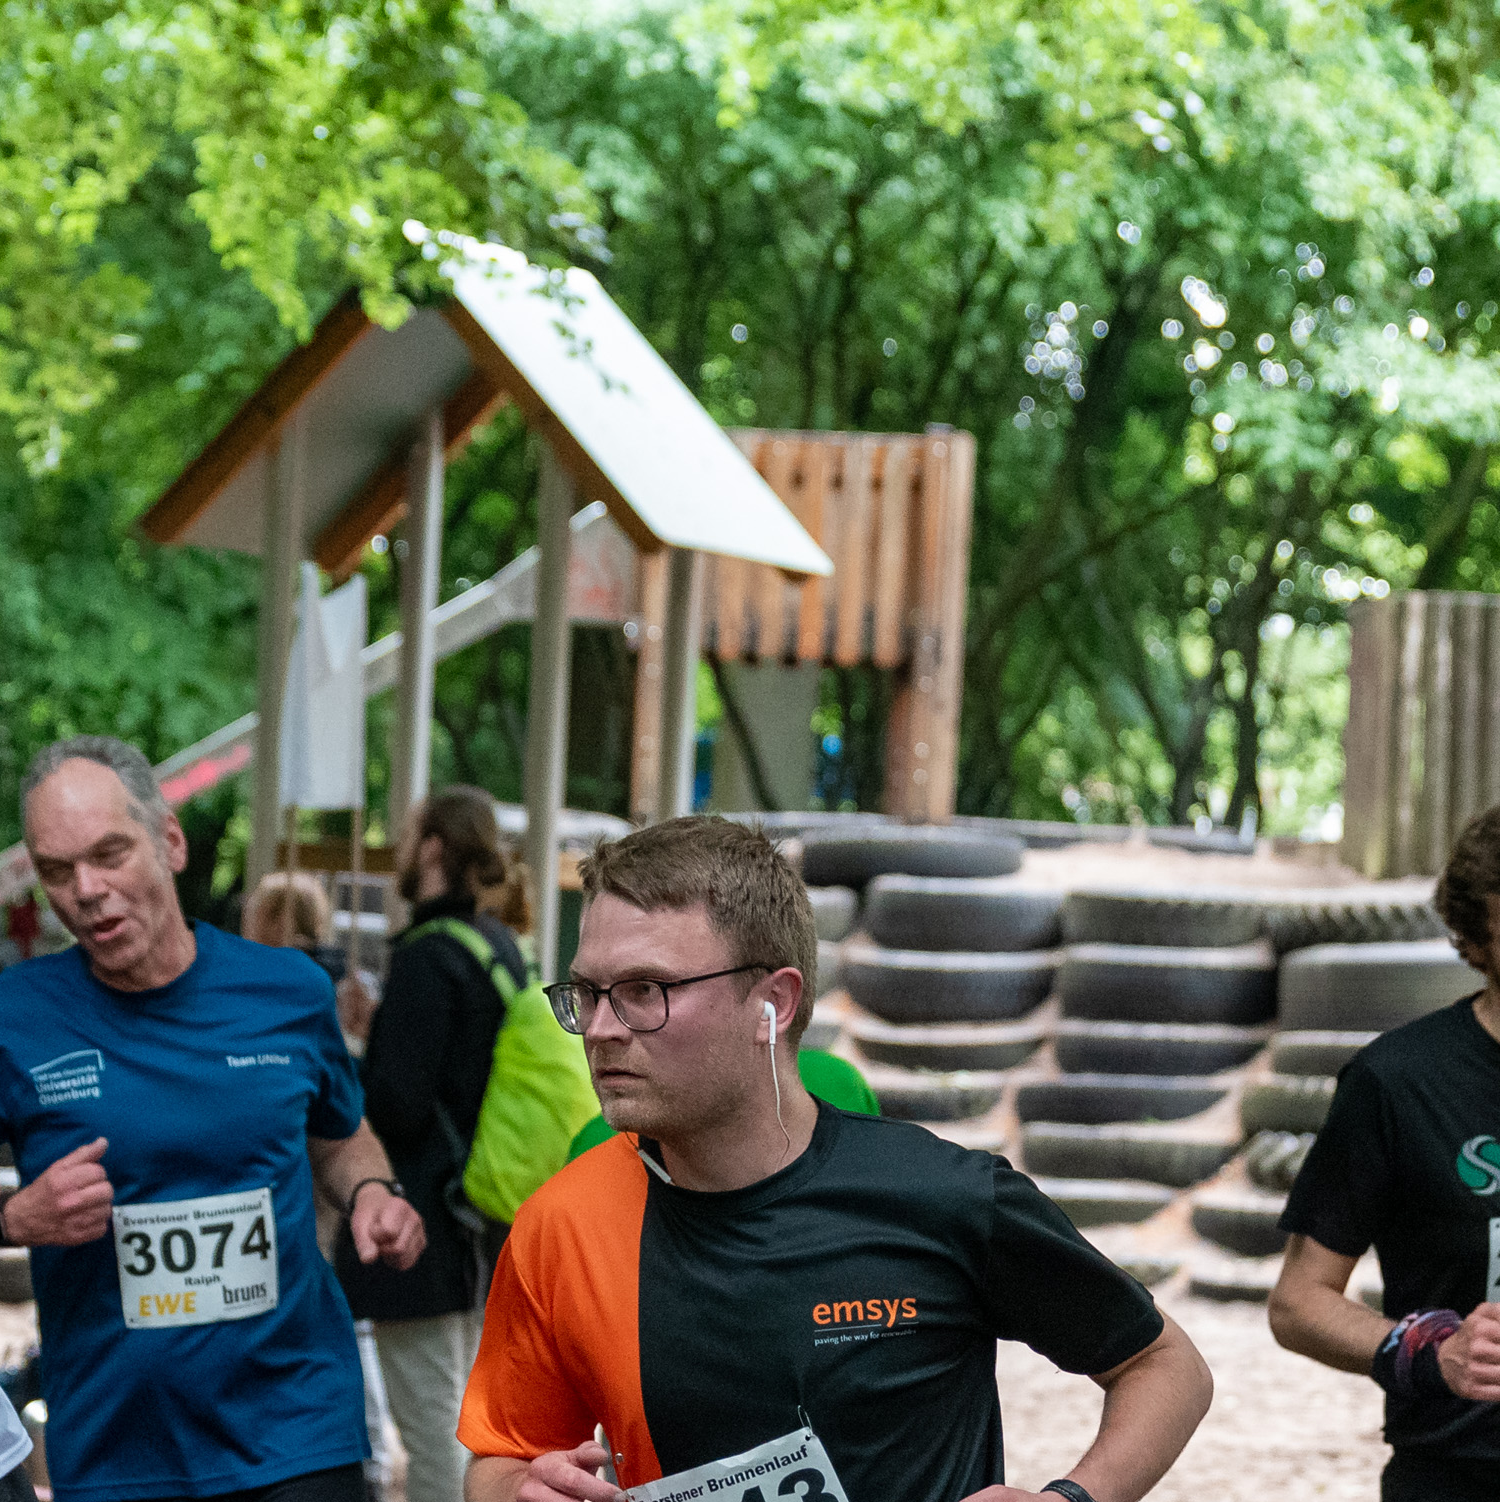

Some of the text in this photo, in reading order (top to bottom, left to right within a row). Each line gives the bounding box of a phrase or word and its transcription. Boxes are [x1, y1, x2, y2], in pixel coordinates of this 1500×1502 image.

[121, 1214, 271, 1277] 3074
[184, 1274, 221, 1287] Ralph
[222, 1281, 268, 1305] bruns
[138, 1291, 197, 1318] EWE
[812, 1297, 918, 1328] emsys
[814, 1335, 840, 1347] paving
[840, 1334, 853, 1342] the
[853, 1332, 869, 1342] way
[869, 1331, 880, 1340] for
[706, 1444, 809, 1493] Brunnenlauf
